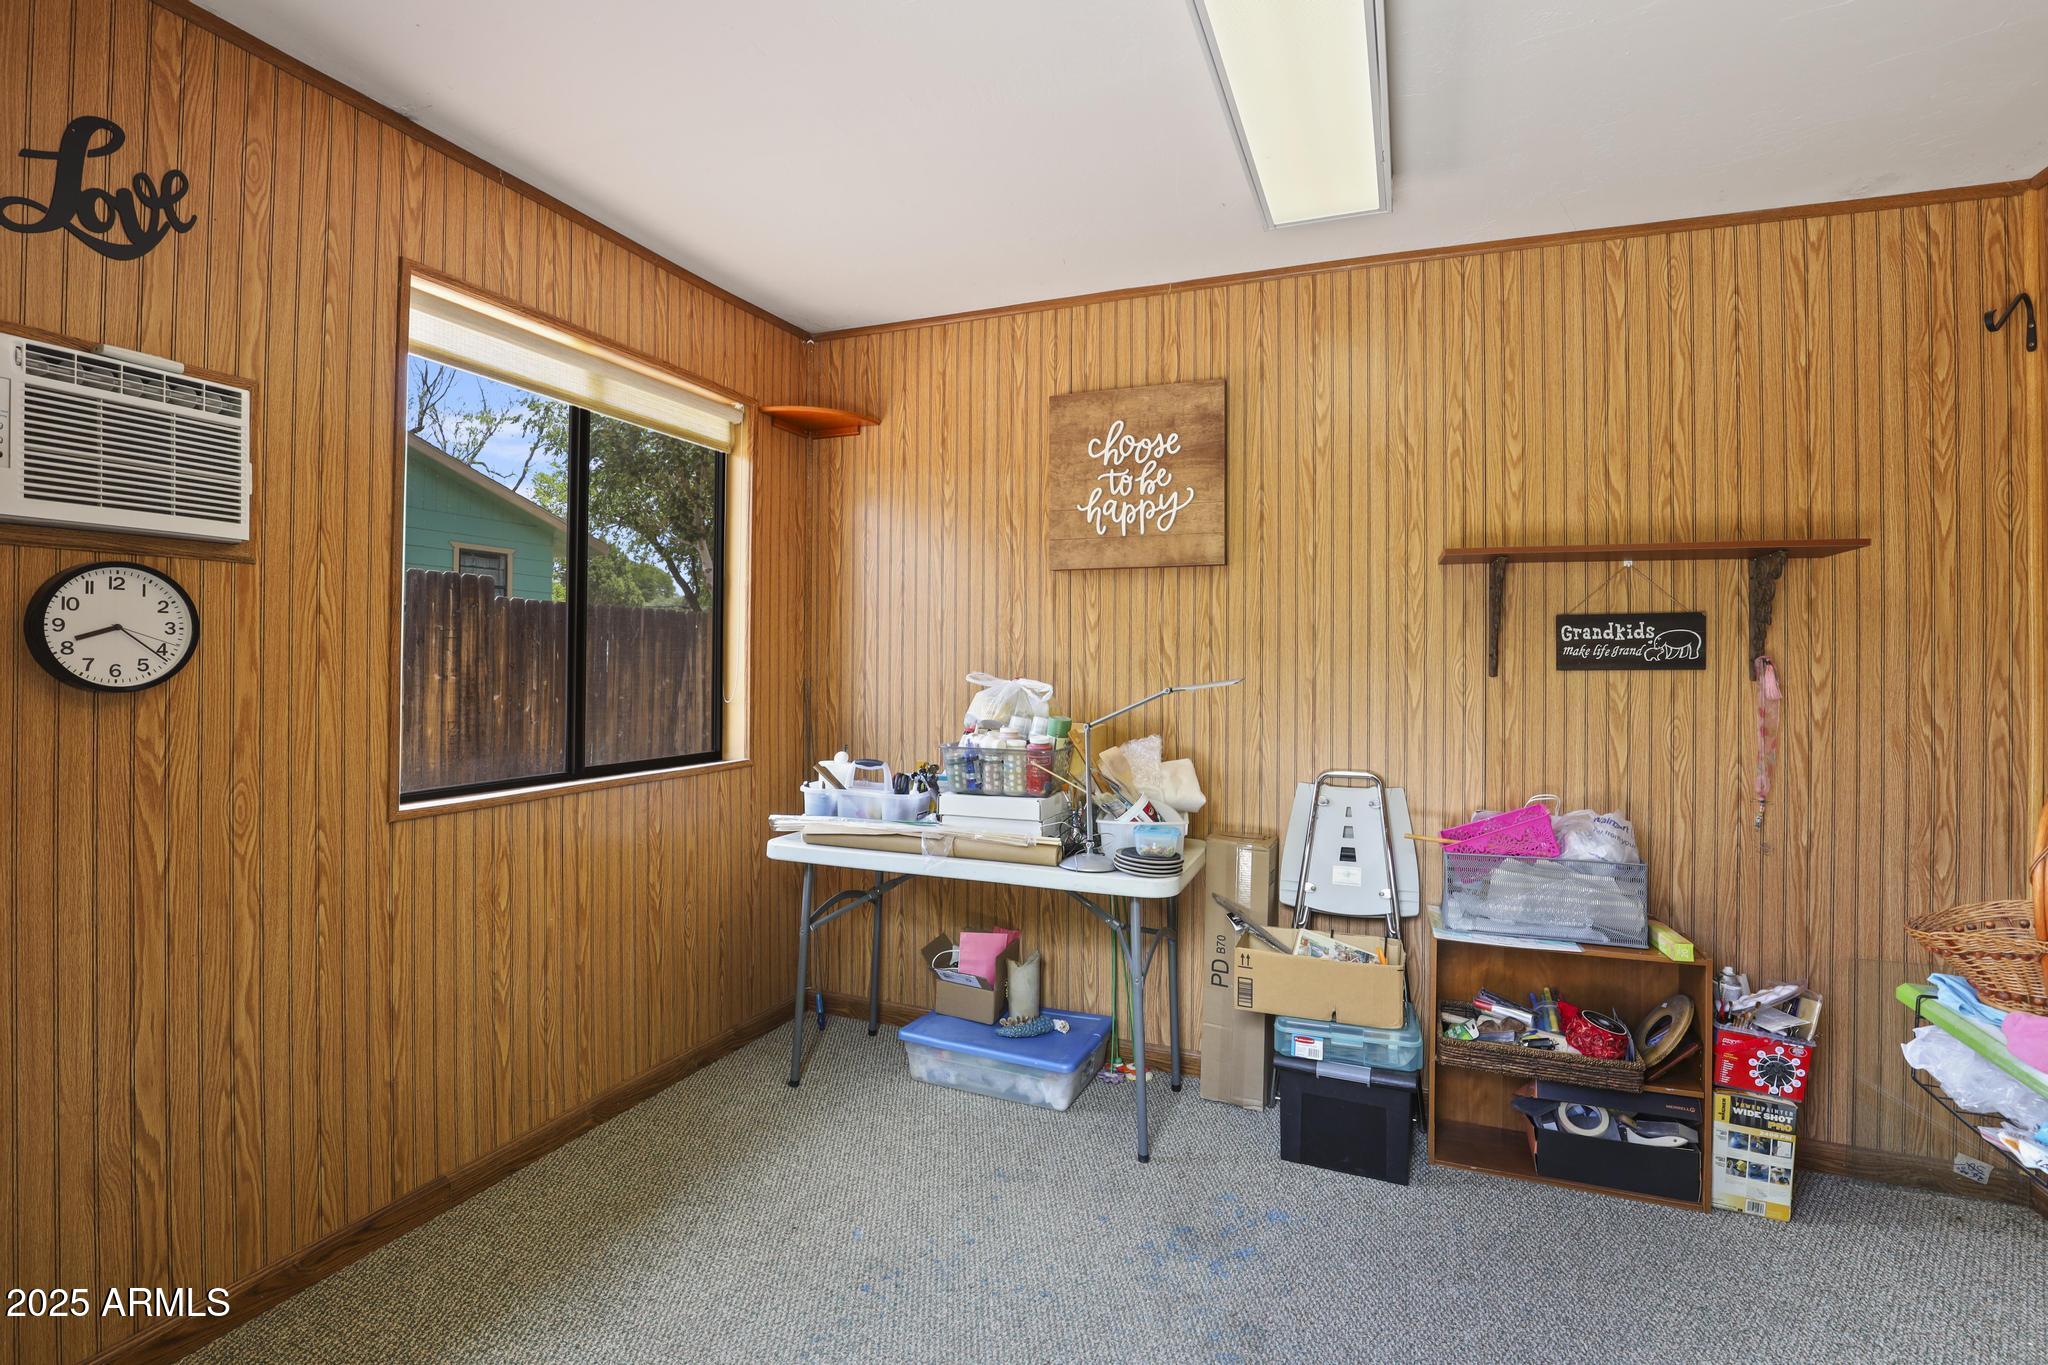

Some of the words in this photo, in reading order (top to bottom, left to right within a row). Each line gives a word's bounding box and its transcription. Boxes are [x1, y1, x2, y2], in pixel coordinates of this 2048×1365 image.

[0, 116, 197, 261] Love
[1088, 420, 1181, 465] choose
[1098, 468, 1133, 496] to
[1135, 460, 1172, 495] be
[1077, 487, 1194, 536] happy
[85, 580, 94, 595] 11
[108, 576, 126, 591] 12
[61, 596, 80, 611] 10
[157, 600, 169, 614] 2
[52, 618, 65, 632] 9
[164, 622, 176, 635] 3
[1561, 621, 1656, 641] Grandkids
[60, 641, 74, 655] 8
[156, 643, 168, 656] 4
[1563, 645, 1591, 659] make
[1592, 644, 1611, 660] life
[1610, 644, 1646, 658] grand
[82, 657, 95, 672] 7
[109, 664, 122, 677] 6
[137, 658, 149, 672] 5
[1216, 934, 1226, 955] B70
[1210, 959, 1230, 988] PD
[1732, 1107, 1762, 1119] WIDE
[1763, 1112, 1794, 1124] SHOT
[1767, 1121, 1793, 1132] PRO
